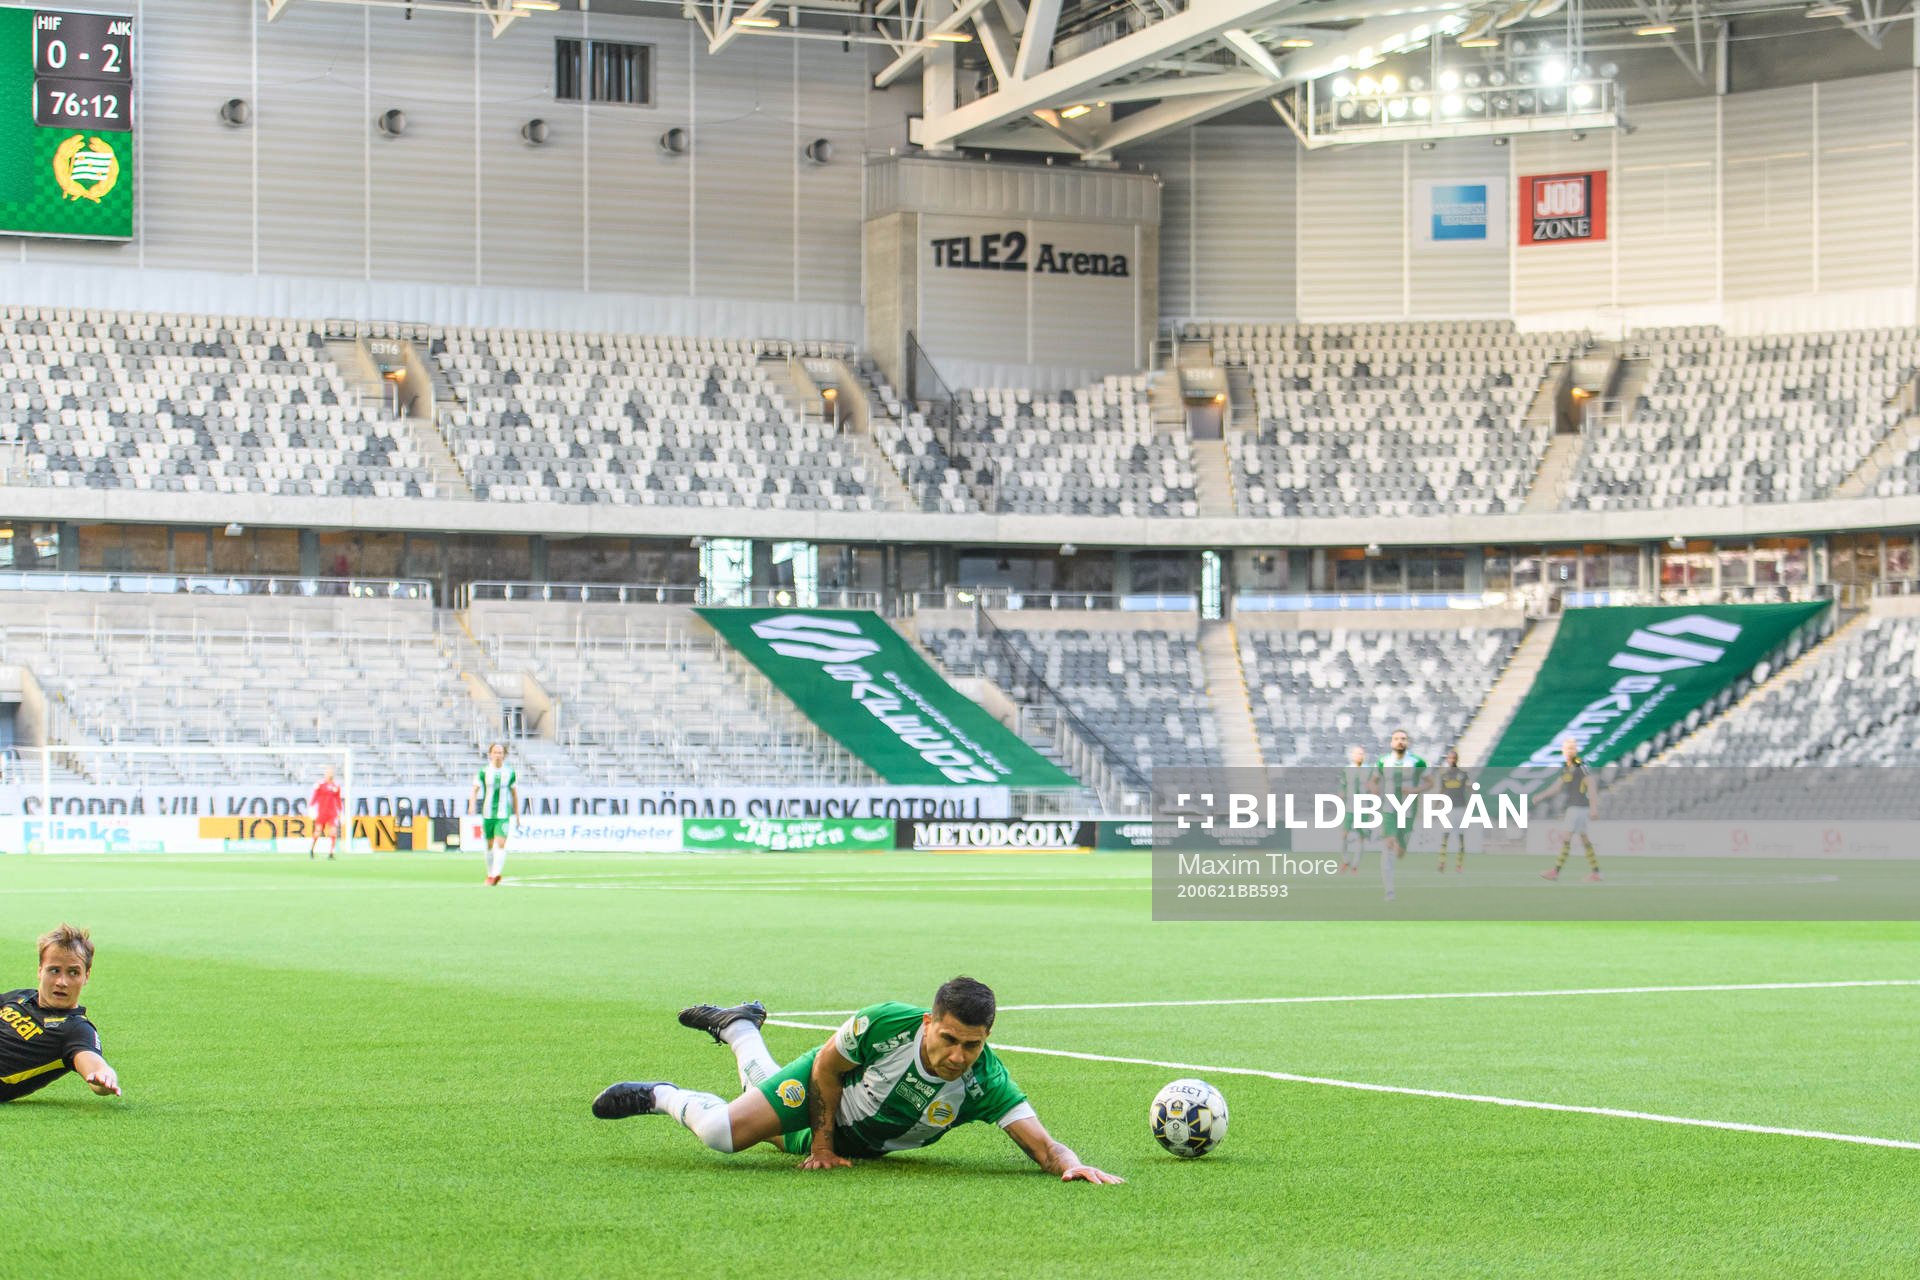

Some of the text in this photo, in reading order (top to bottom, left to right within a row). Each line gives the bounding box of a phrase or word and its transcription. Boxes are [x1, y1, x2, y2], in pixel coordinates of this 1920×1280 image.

[37, 16, 131, 36] HIF AIK
[47, 40, 67, 69] 0
[102, 44, 121, 73] 2
[50, 91, 119, 119] 76:12
[1536, 182, 1583, 216] JOB
[1533, 217, 1591, 240] ZONE
[930, 231, 1129, 277] TELE2 Arena
[571, 824, 673, 841] Fastigheter
[913, 821, 1080, 846] METODGOLV
